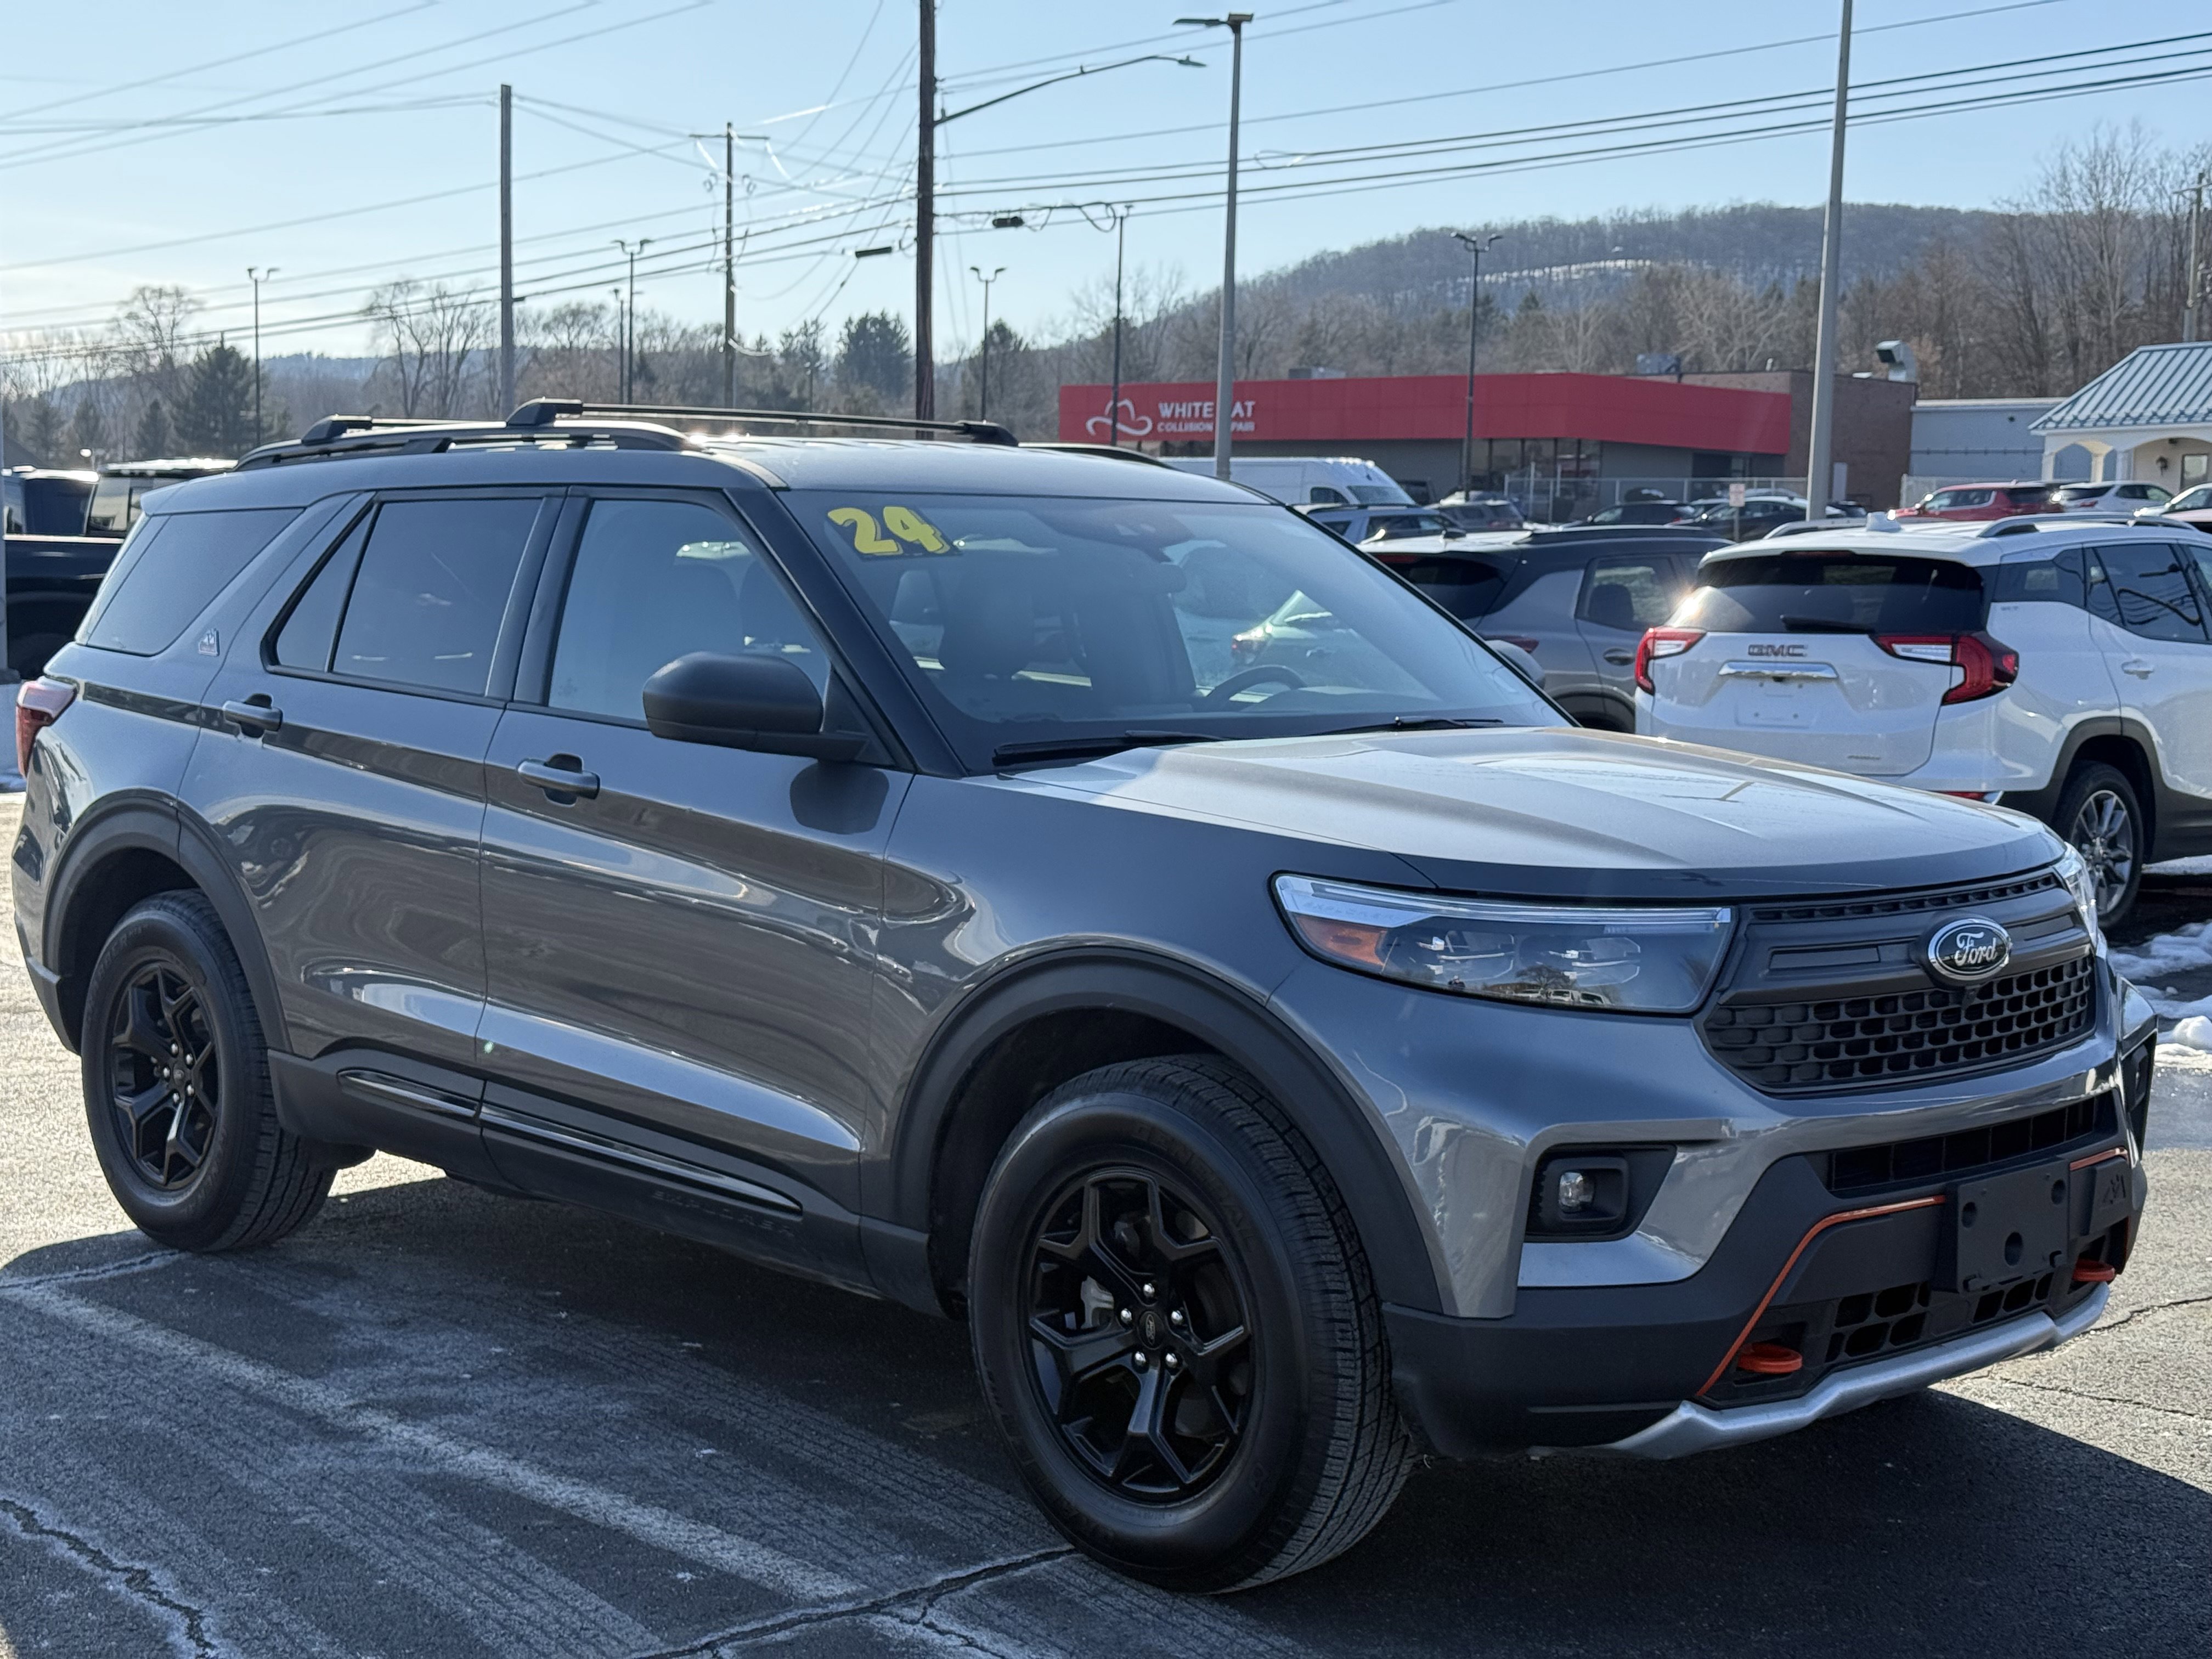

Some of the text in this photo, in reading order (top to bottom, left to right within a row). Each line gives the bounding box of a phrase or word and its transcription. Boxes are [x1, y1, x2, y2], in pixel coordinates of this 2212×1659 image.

[1158, 401, 1214, 419] WHITE
[1156, 421, 1255, 432] COLLISION PAIR
[827, 506, 950, 555] 24
[1748, 644, 1808, 657] GMC
[1955, 932, 1998, 966] Ford
